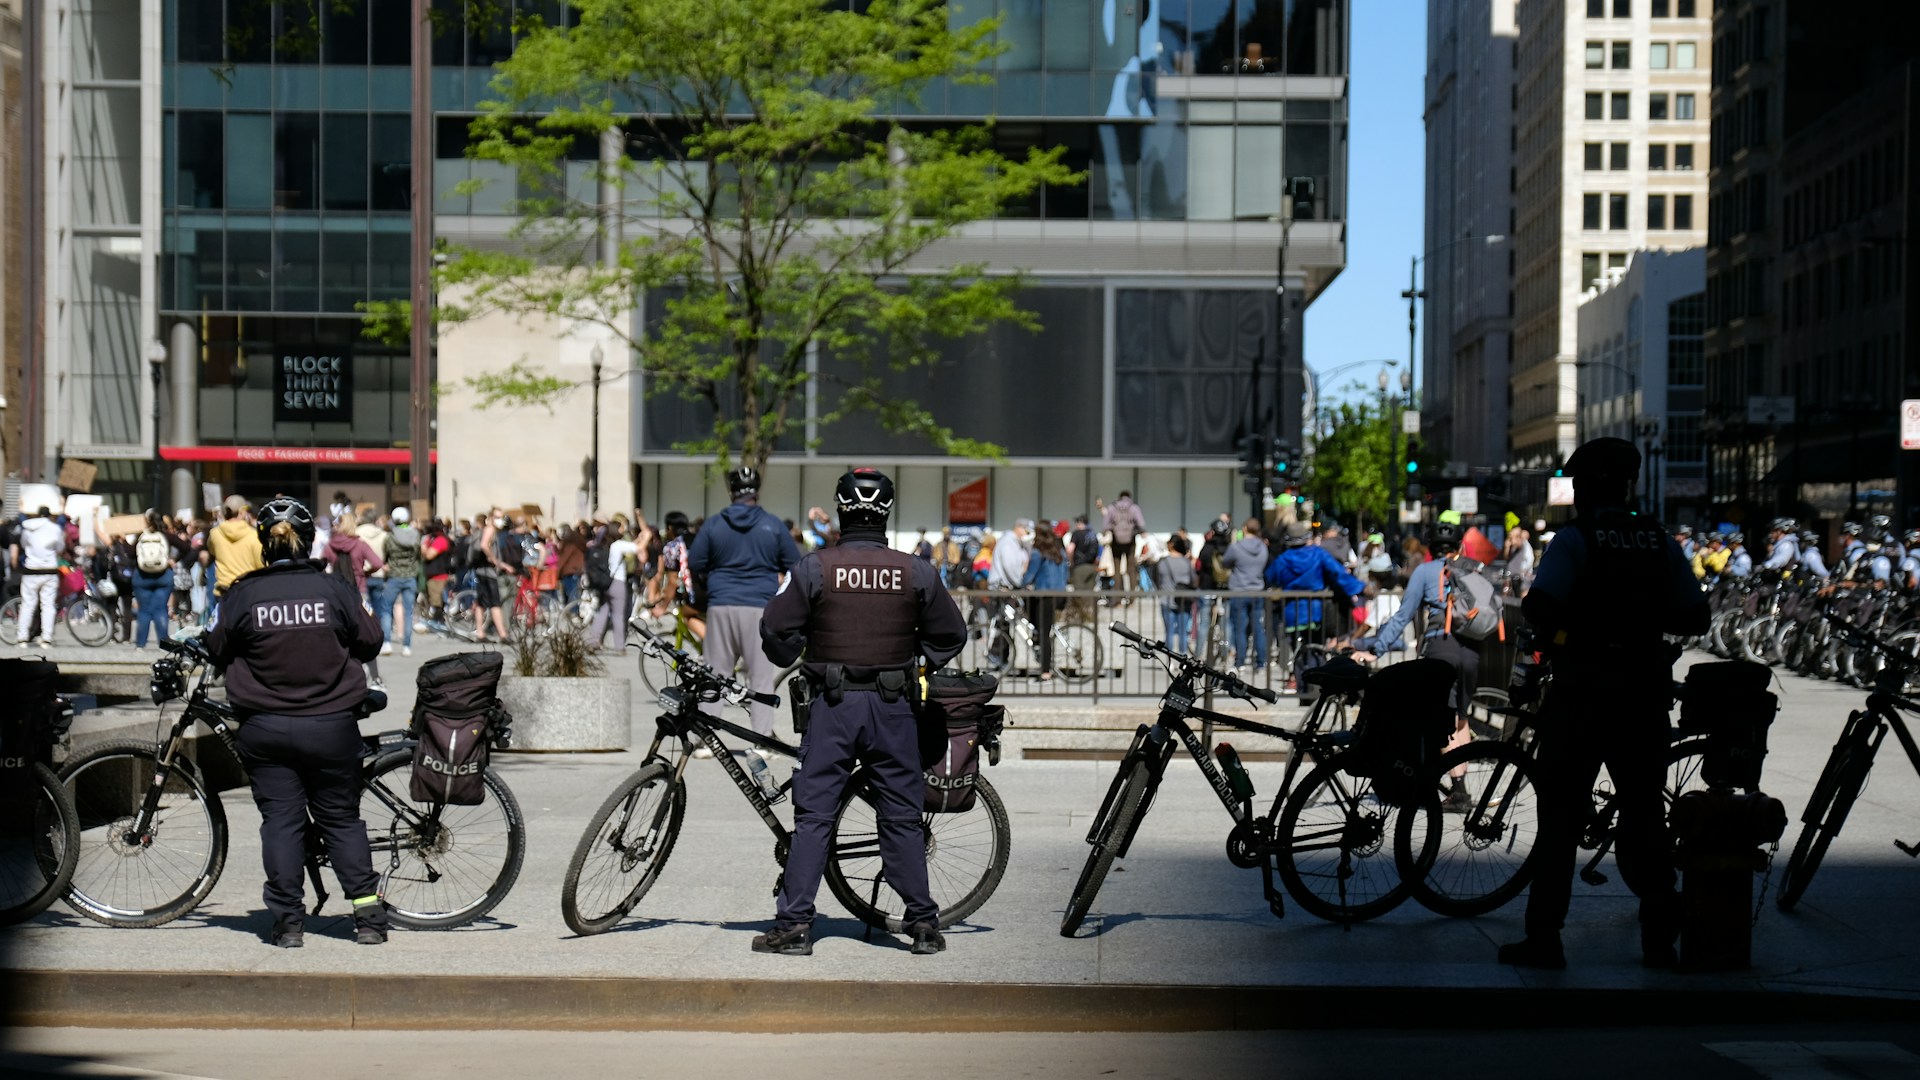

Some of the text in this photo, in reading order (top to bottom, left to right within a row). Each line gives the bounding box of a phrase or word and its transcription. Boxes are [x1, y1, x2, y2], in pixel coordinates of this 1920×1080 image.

[283, 355, 341, 374] BLOCK
[284, 374, 341, 391] THIRTY
[283, 390, 340, 409] SEVEN
[274, 449, 317, 460] FASHION
[325, 450, 355, 461] FILMS
[1595, 529, 1660, 549] POLICE
[836, 567, 902, 590] POLICE
[256, 602, 326, 628] POLICE
[422, 754, 479, 776] POLICE
[704, 734, 771, 817] CHICAGO POLICE
[1186, 733, 1240, 811] CHICAGO POLICE
